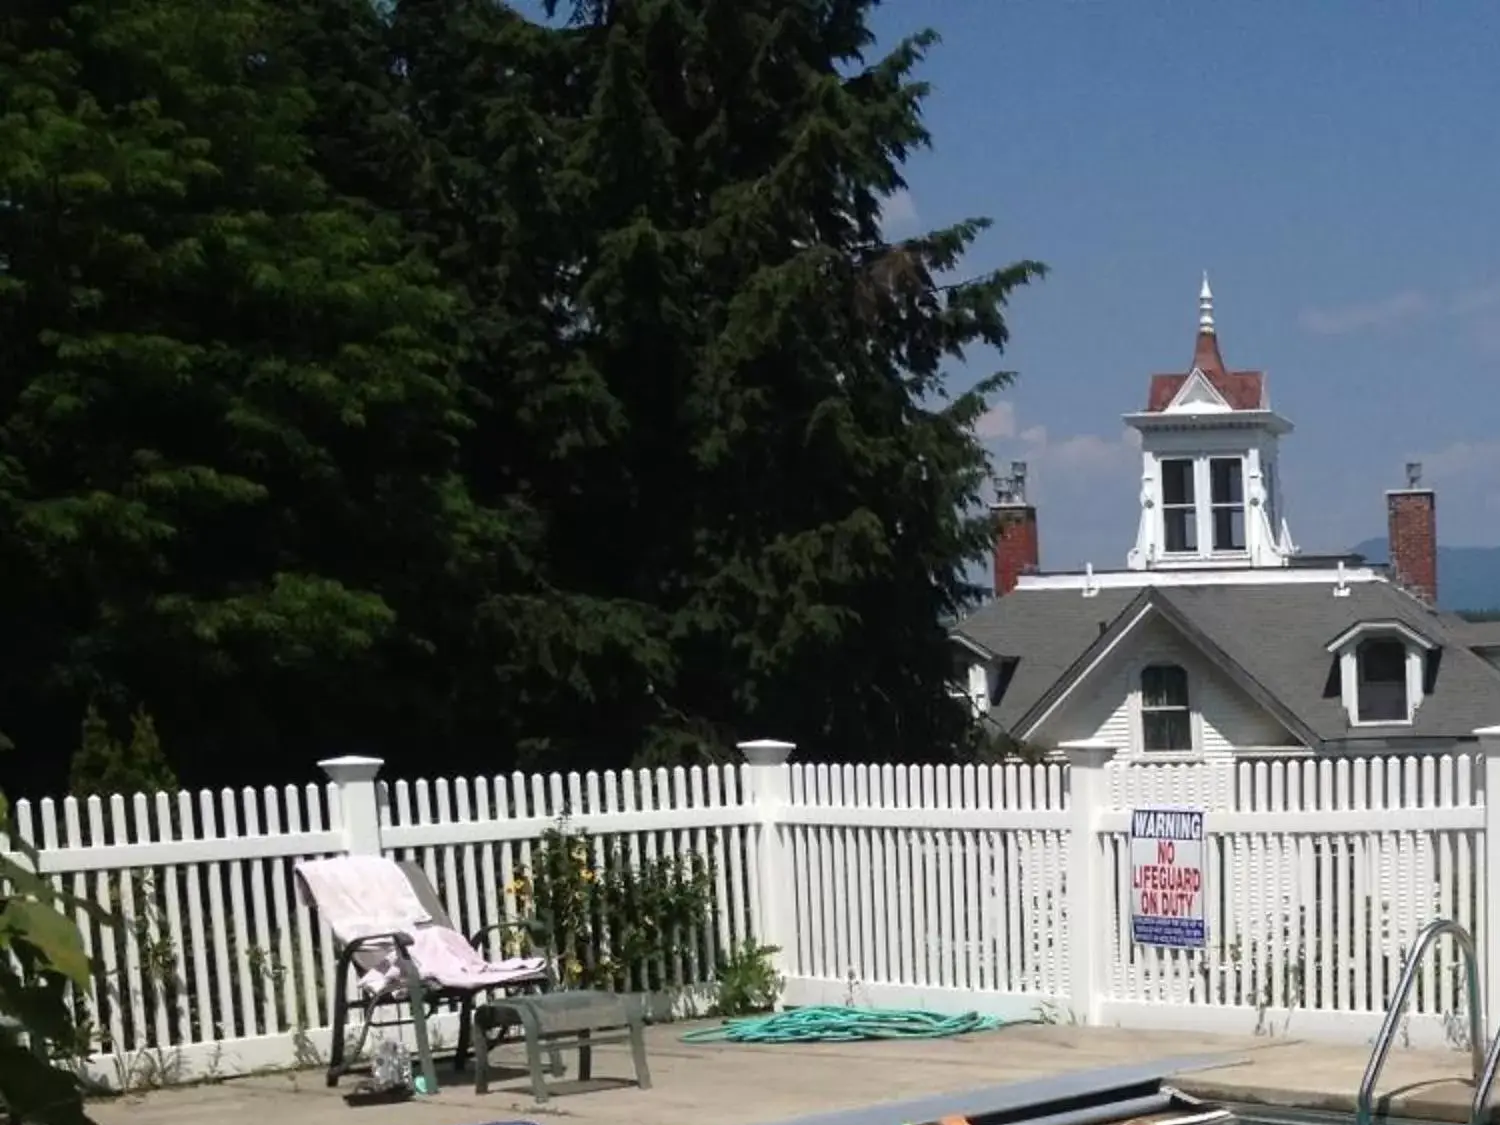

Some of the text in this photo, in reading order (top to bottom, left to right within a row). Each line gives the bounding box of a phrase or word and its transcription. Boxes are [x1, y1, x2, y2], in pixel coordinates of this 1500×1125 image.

[1135, 812, 1201, 839] WARNING
[1157, 841, 1175, 865] NO
[1134, 866, 1201, 892] LIFEGUARD
[1141, 891, 1194, 917] ON DUTY
